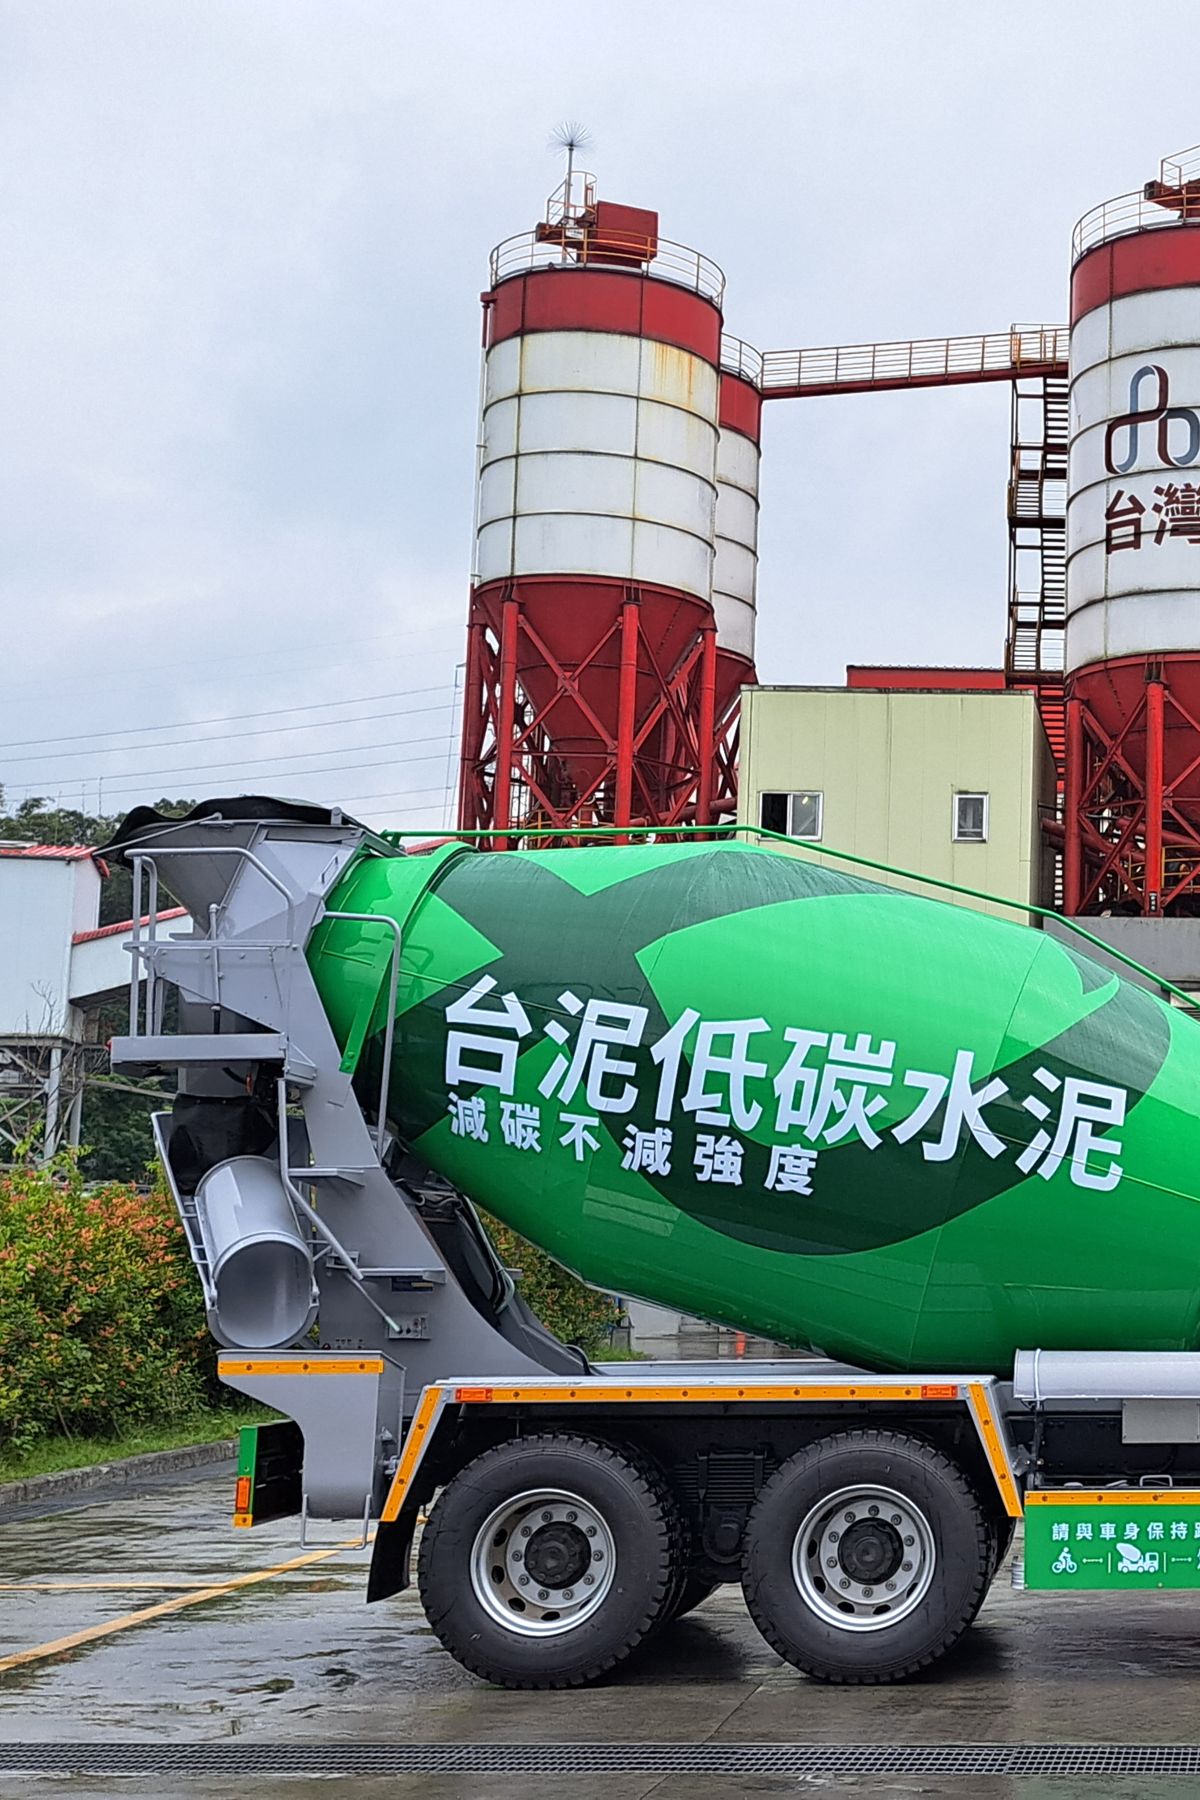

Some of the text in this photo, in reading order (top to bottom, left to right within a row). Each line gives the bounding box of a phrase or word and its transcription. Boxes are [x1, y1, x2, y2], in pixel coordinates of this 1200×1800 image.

[444, 974, 1129, 1192] 台泥低碳水泥
[447, 1091, 819, 1197] 減碳不減強度
